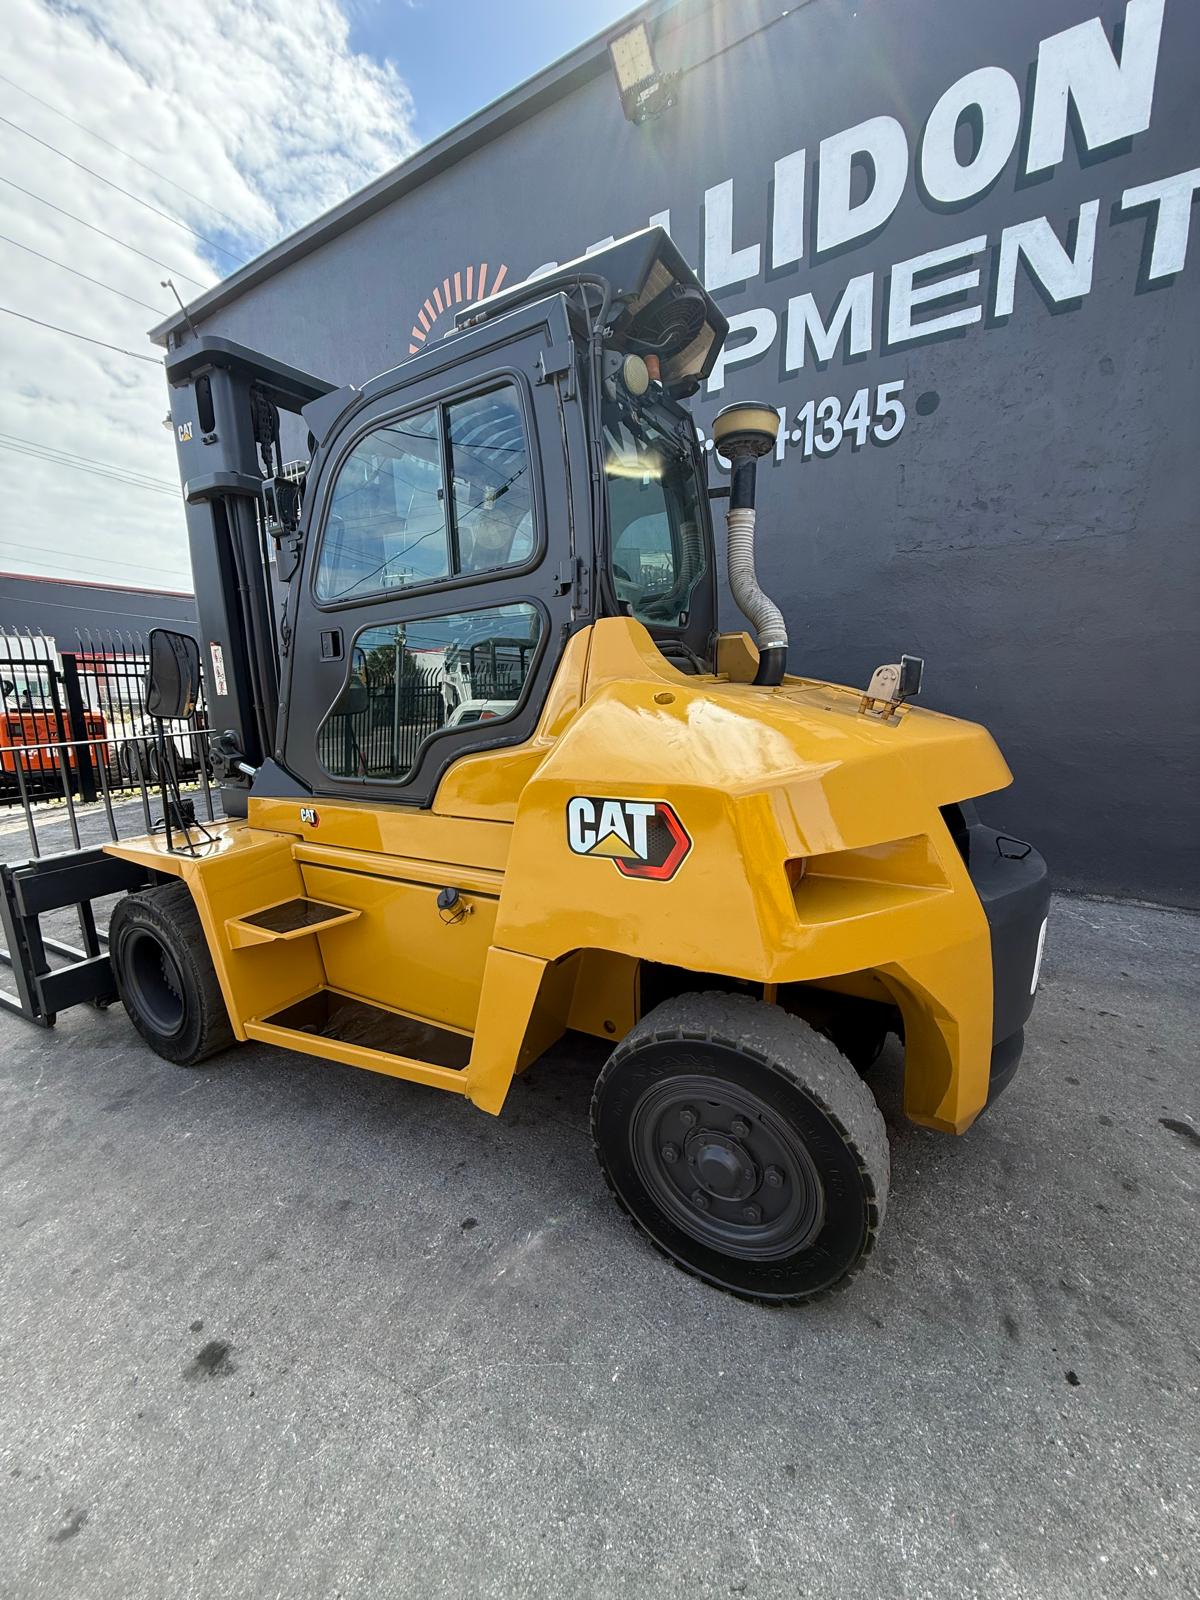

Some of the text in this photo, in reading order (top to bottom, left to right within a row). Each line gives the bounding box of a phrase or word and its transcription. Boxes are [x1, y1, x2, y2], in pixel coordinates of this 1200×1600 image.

[706, 168, 1200, 393] PMENT
[178, 421, 193, 442] CAT
[300, 808, 315, 823] CAT
[568, 797, 655, 860] CAT
